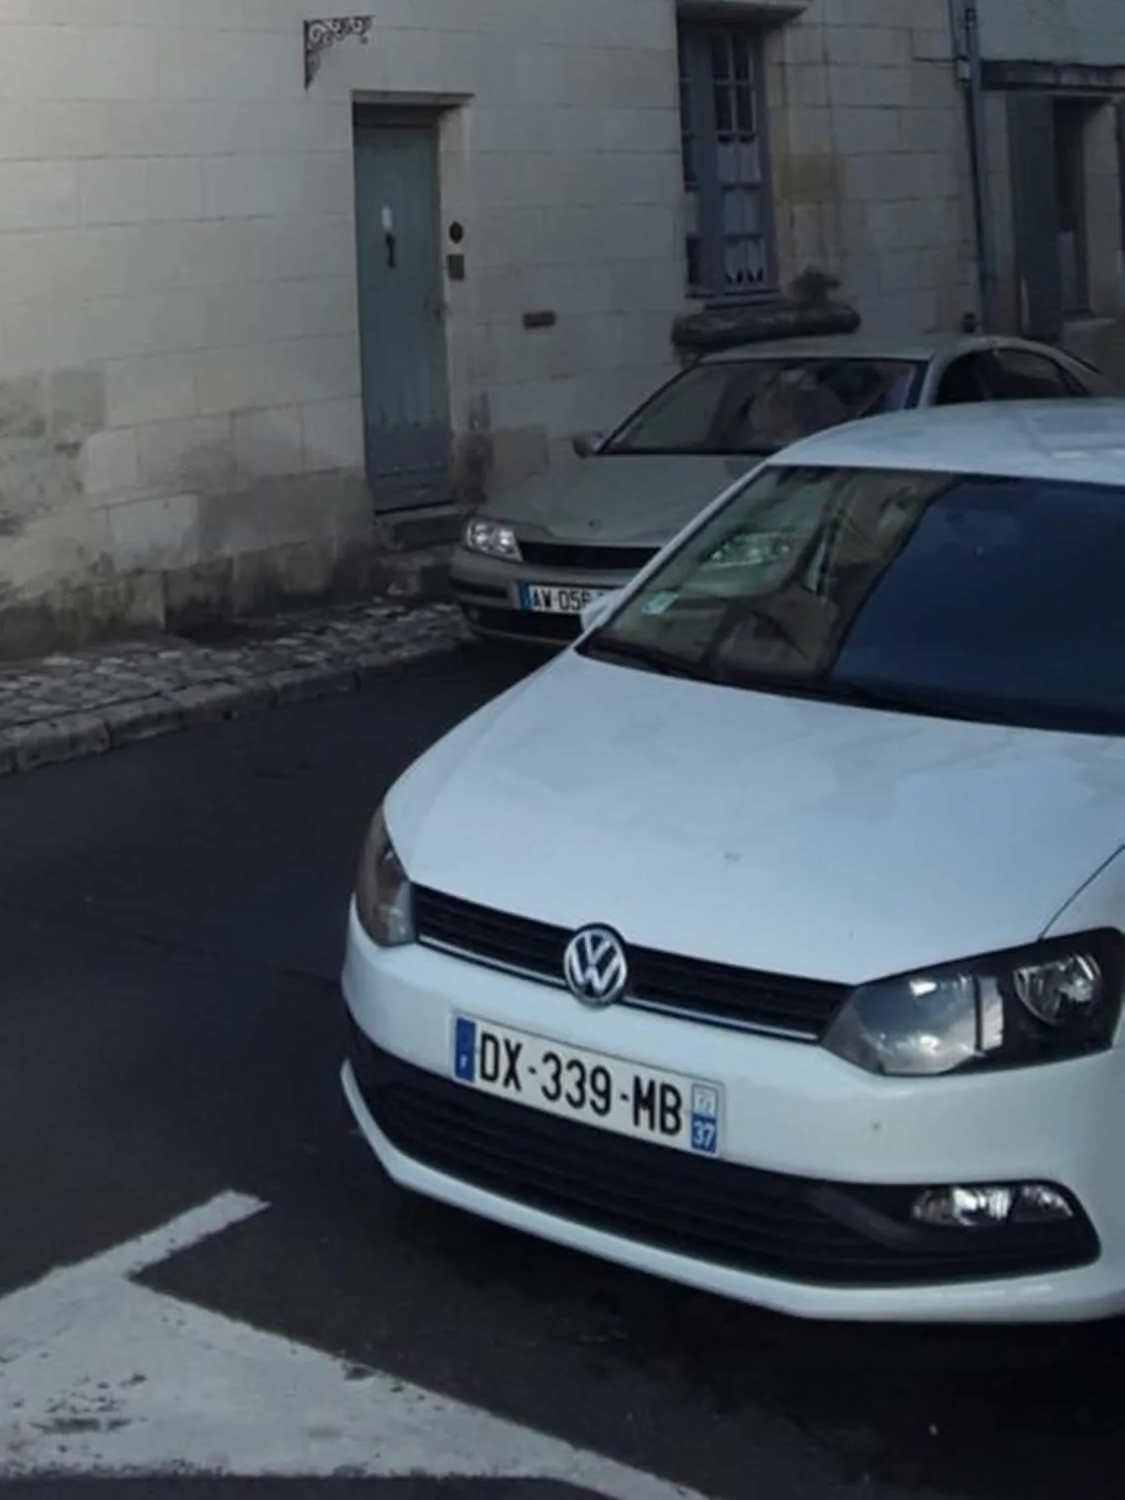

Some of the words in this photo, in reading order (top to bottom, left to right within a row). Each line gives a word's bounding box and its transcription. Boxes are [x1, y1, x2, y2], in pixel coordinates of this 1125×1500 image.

[569, 930, 621, 996] VW
[480, 1031, 683, 1136] DX-339-MB
[694, 1120, 715, 1149] 37
